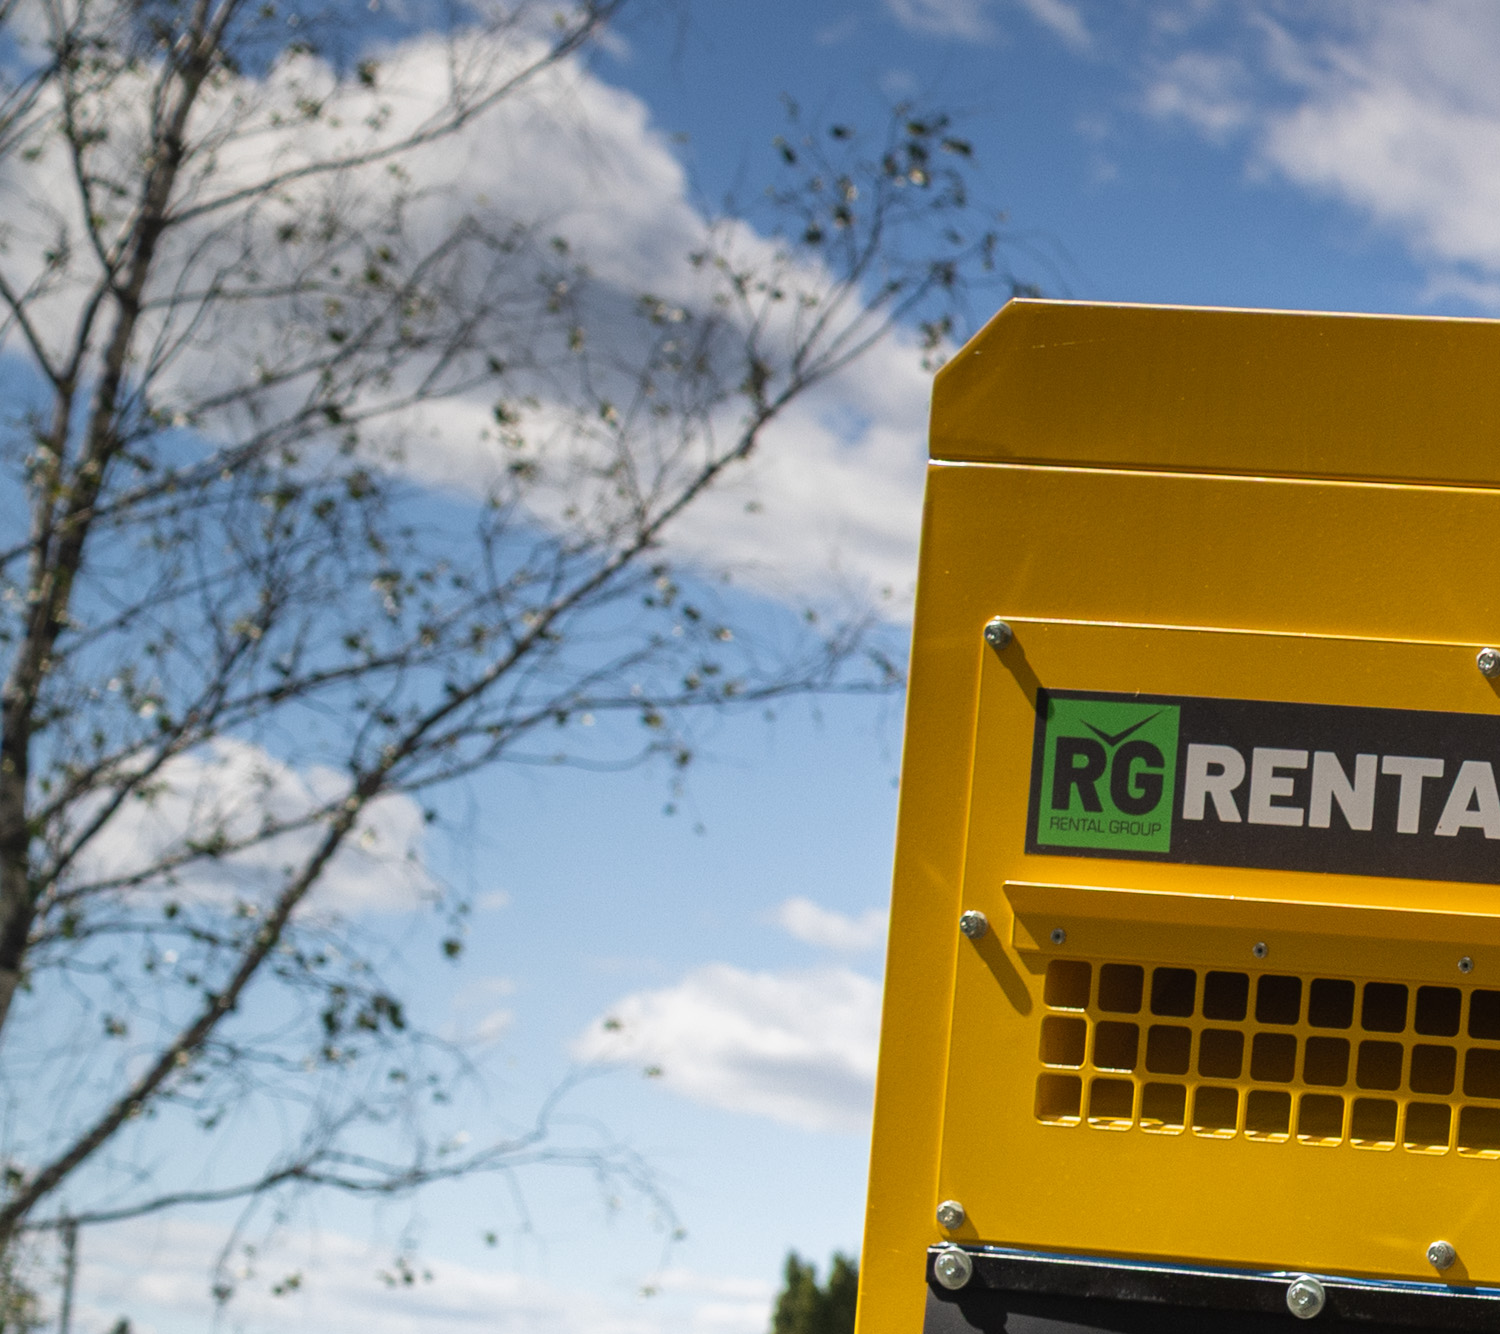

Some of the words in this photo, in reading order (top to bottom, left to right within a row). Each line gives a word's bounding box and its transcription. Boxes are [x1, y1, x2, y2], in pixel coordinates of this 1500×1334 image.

[1051, 736, 1165, 816] RG
[1050, 816, 1105, 834] RENTAL
[1109, 820, 1162, 837] GROUP
